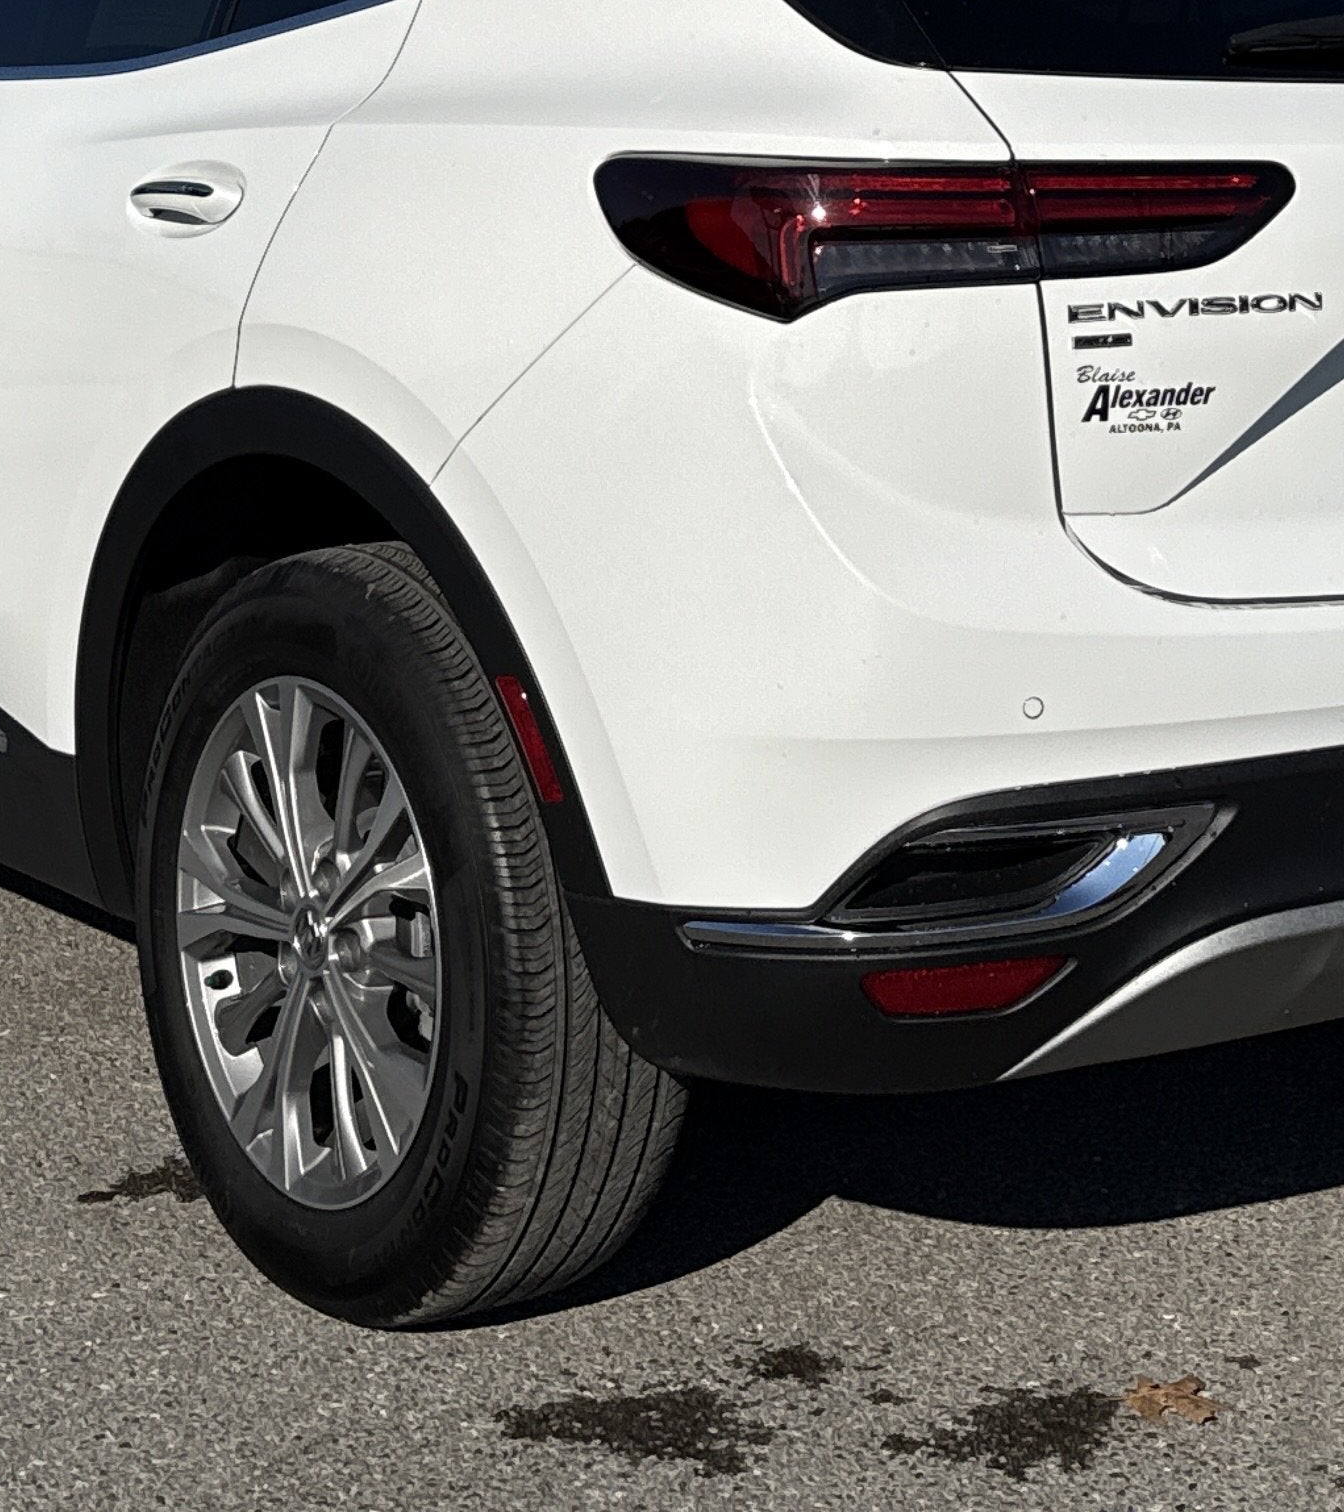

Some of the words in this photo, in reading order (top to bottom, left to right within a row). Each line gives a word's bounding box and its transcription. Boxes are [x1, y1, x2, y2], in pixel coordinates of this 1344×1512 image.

[1067, 292, 1323, 324] ENVISION
[1076, 365, 1135, 383] Blaise
[1081, 382, 1216, 423] Alexander
[1166, 422, 1182, 432] PA
